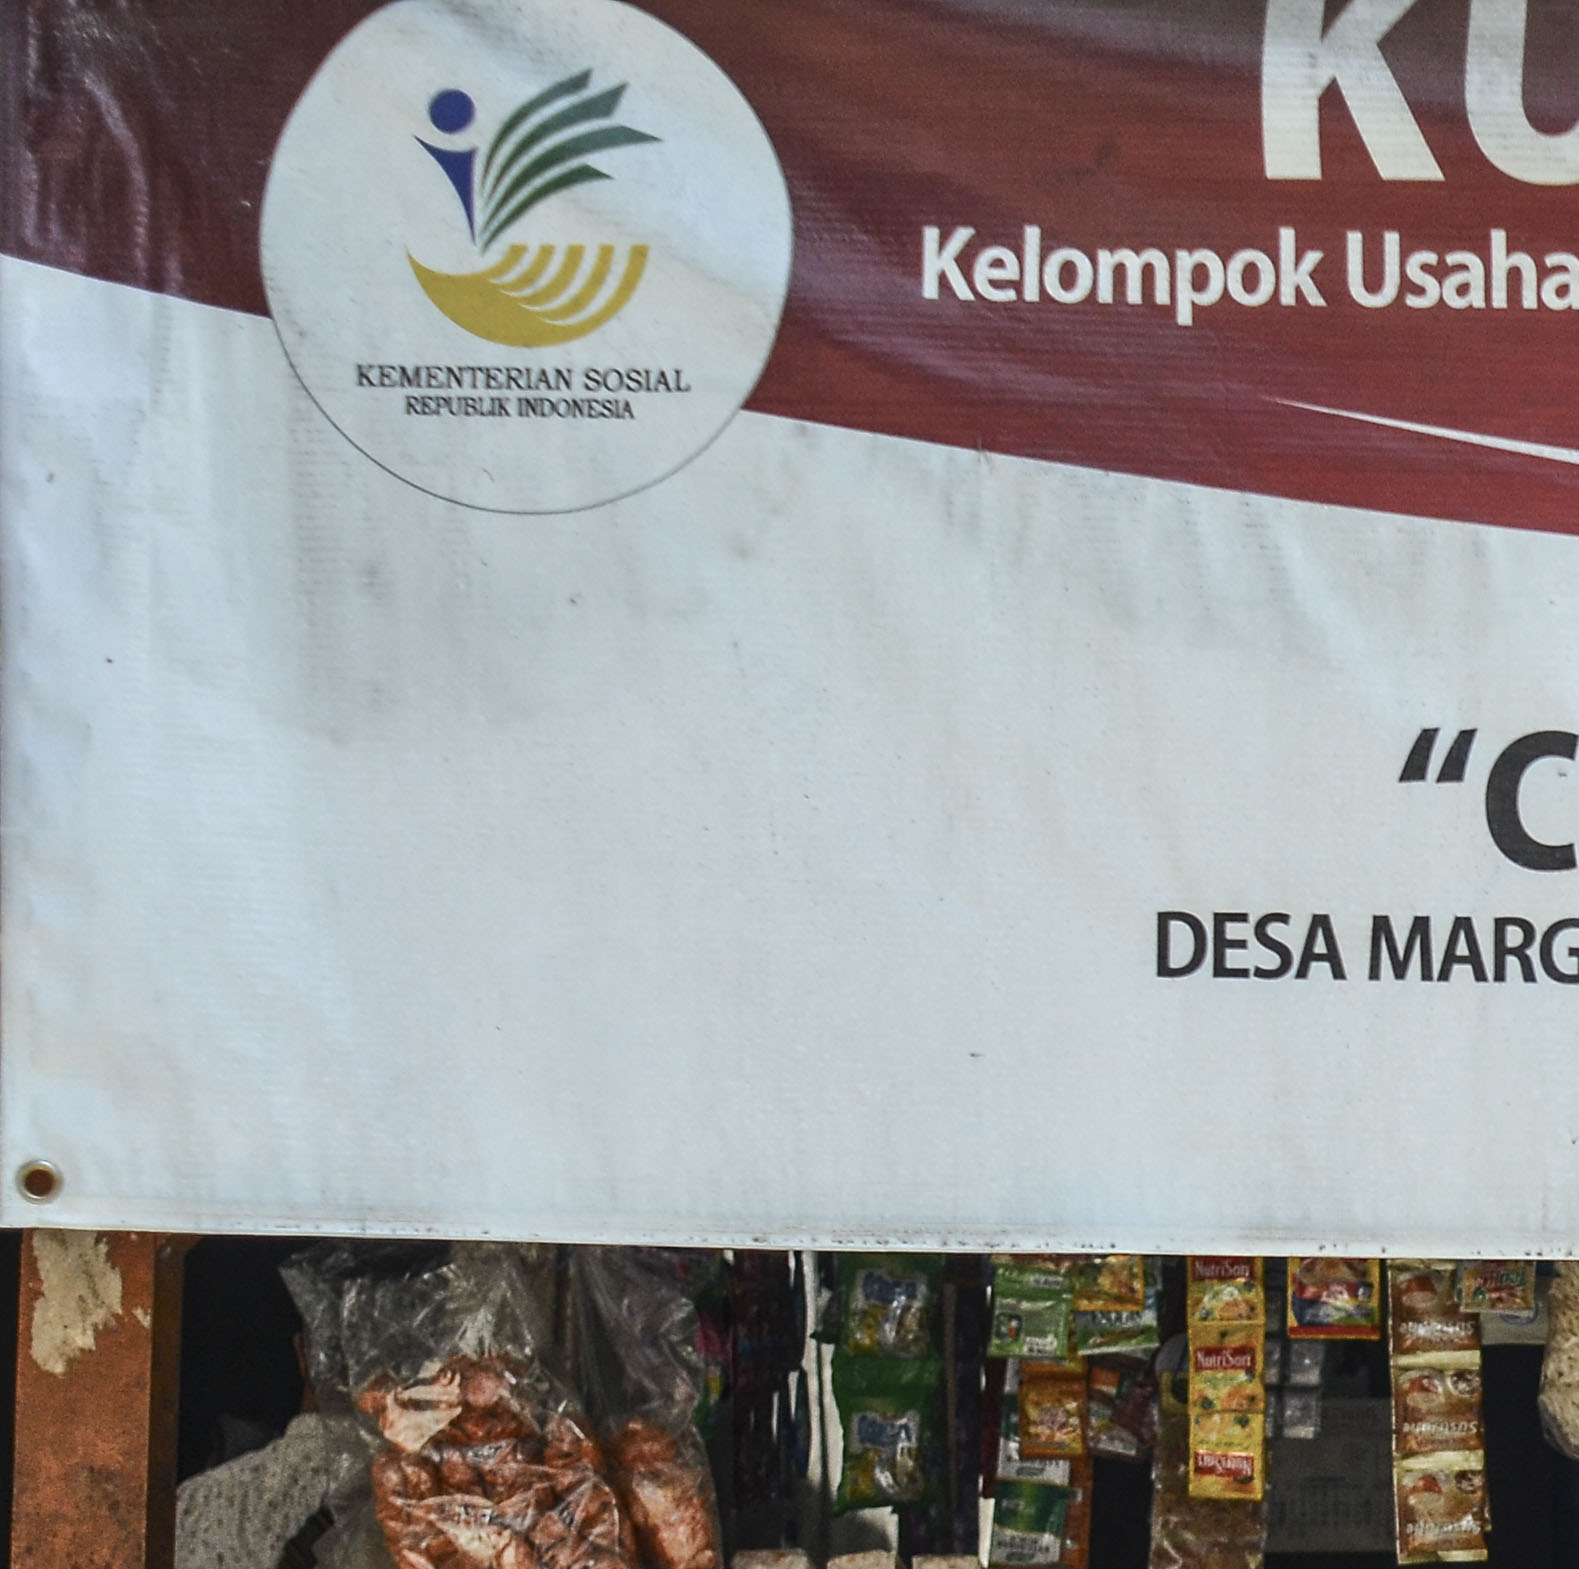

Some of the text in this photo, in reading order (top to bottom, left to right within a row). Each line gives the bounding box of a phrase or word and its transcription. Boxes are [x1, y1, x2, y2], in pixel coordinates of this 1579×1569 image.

[921, 225, 1325, 325] Kelompok
[356, 364, 692, 393] KEMENTERIAN SOSIAL
[404, 395, 635, 420] REPUBLIK INDONESIA
[1152, 910, 1347, 982] DESA
